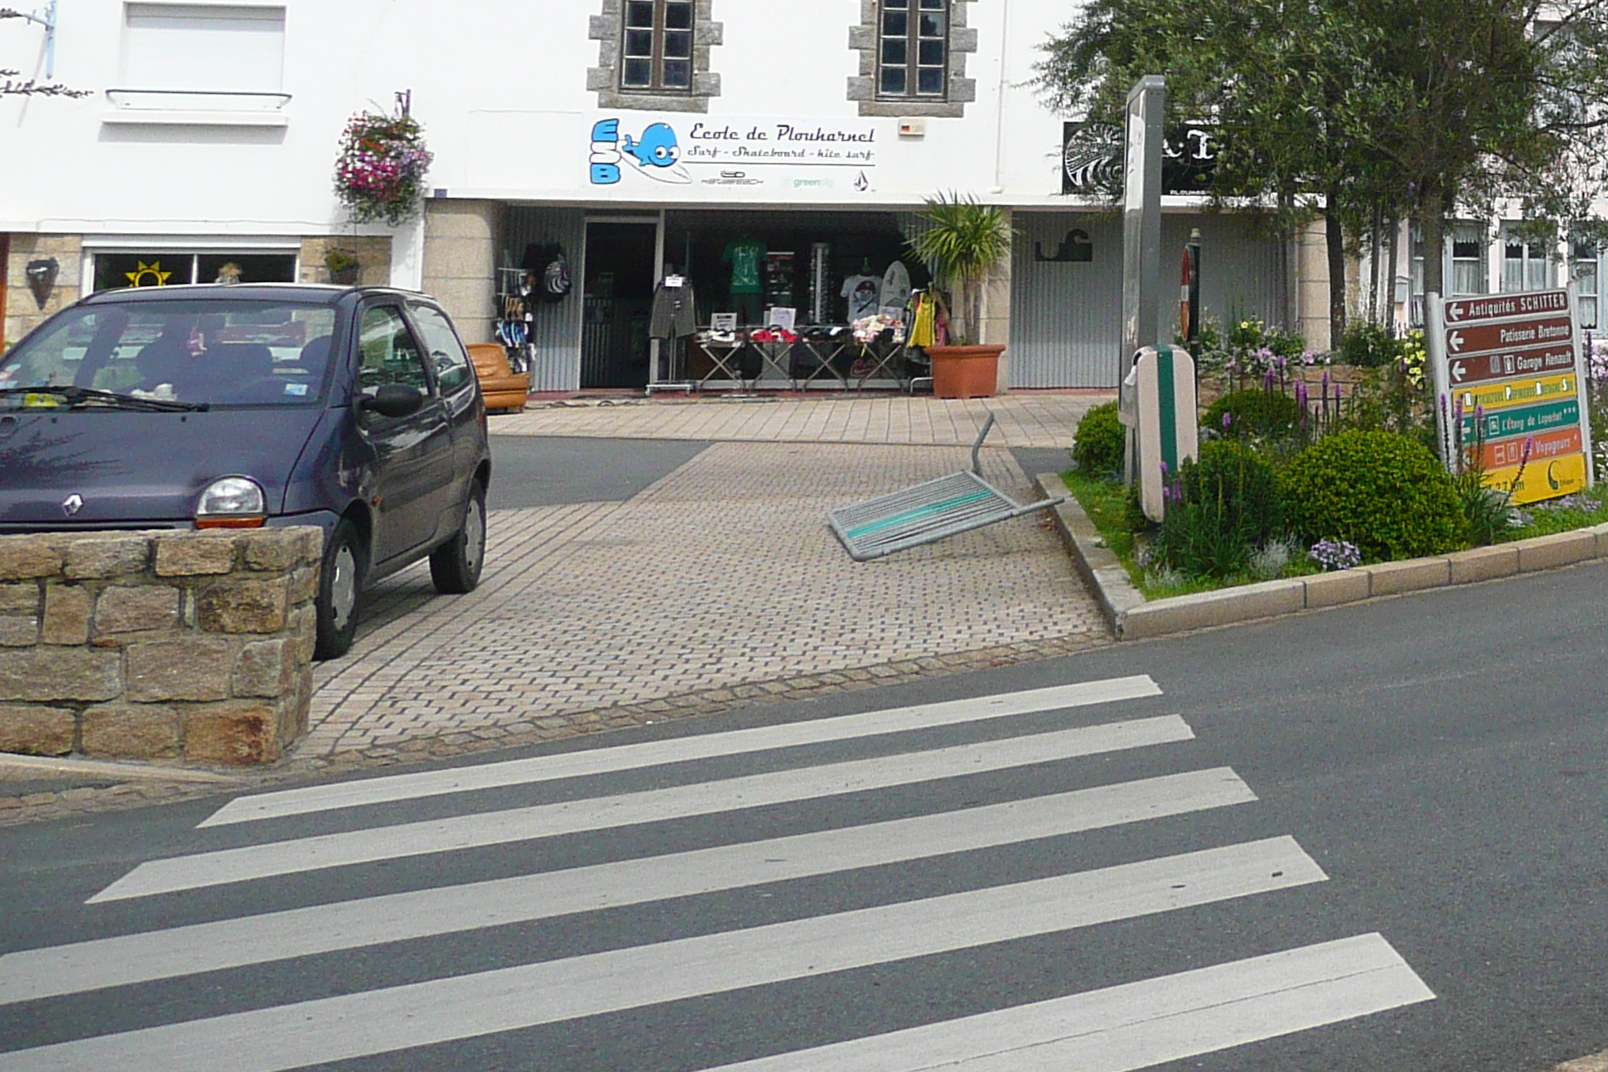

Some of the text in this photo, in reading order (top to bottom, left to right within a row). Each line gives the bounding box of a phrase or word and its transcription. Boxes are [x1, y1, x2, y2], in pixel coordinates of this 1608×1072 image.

[690, 122, 876, 143] Ecole de Plouharnel
[687, 145, 722, 158] Surf
[817, 148, 841, 159] kite
[845, 151, 875, 161] surf
[1468, 293, 1565, 318] Antiquités SCHITTER
[1517, 356, 1542, 371] Garage
[1527, 416, 1536, 426] de
